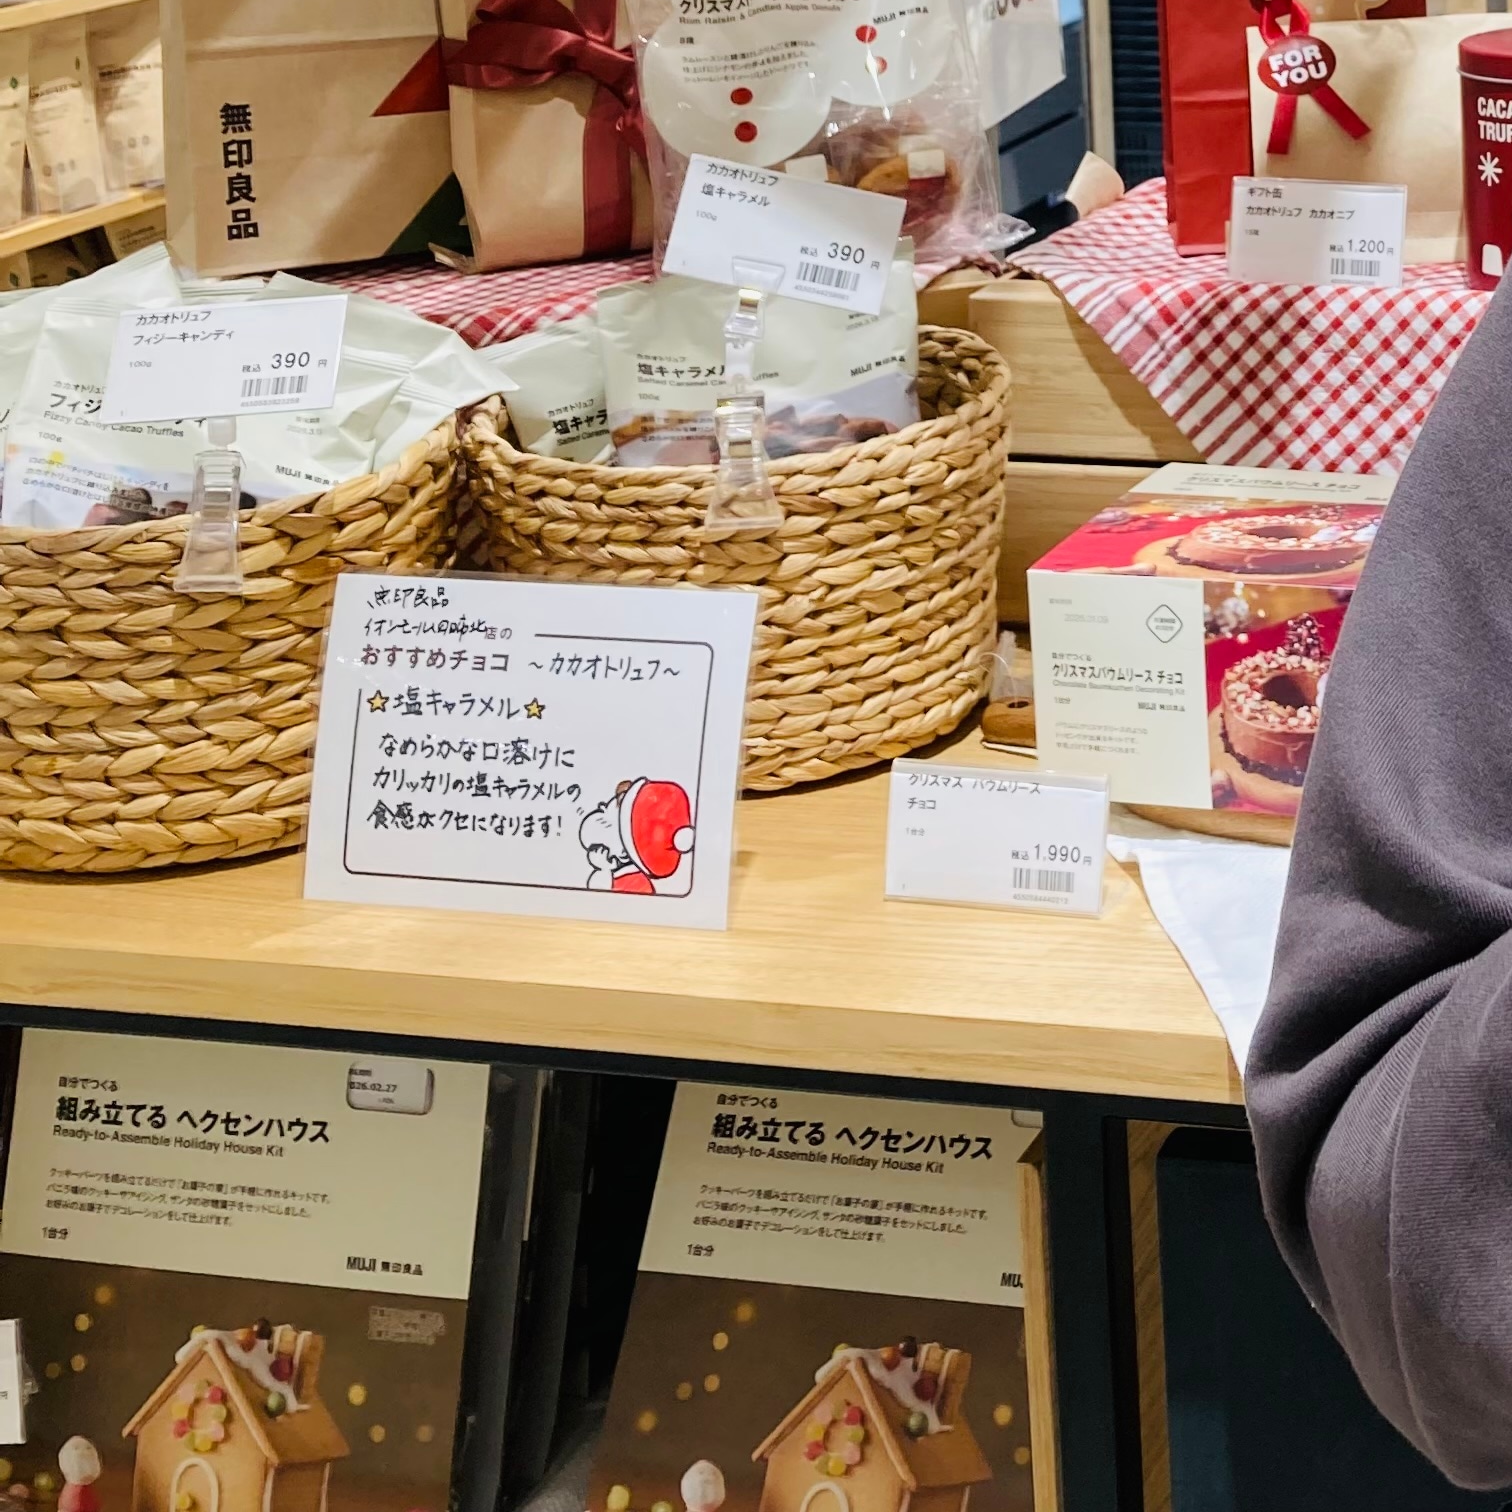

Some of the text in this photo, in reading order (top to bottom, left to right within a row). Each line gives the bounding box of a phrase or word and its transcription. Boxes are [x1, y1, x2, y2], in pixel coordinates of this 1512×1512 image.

[1268, 45, 1322, 71] FOR
[1271, 61, 1327, 87] YOU
[219, 102, 259, 241] 無印良品
[706, 163, 778, 186] カカオトリュフ
[701, 183, 771, 207] 塩キャラメル
[1246, 206, 1302, 218] カカオトリュフ
[827, 242, 865, 264] 390
[136, 311, 212, 326] カカオトリュフ
[132, 329, 235, 346] フィジーキャンディ
[271, 351, 310, 370] 390
[850, 363, 872, 377] MUJI
[43, 410, 71, 424] Fizzy
[111, 423, 142, 434] Cacao
[146, 425, 184, 437] Truffles
[275, 465, 301, 478] MUJI
[361, 644, 510, 672] おすすめチョコ
[1052, 663, 1183, 684] クリスマスバウムリース チョコ
[379, 733, 575, 768] なめらかな口溶けに
[372, 766, 581, 801] カリッカリの塩キャラメルの
[909, 773, 962, 788] クリスマス
[907, 797, 936, 809] チョコ
[1034, 844, 1080, 863] 1,990
[59, 1076, 118, 1092] 自分でつくる
[716, 1094, 778, 1109] 自分でつくる
[56, 1096, 330, 1144] 組み立てる ヘクセンハウス
[53, 1125, 284, 1157] Ready-to-Assemble Holiday House Kit
[712, 1112, 993, 1160] 組み立てる ヘクセンハウス
[707, 1142, 943, 1174] Ready-to-Assemble Holiday House Kit
[42, 1227, 68, 1240] 1台分
[687, 1244, 714, 1257] 1台分
[346, 1256, 376, 1272] MUJI
[1000, 1272, 1023, 1289] MU
